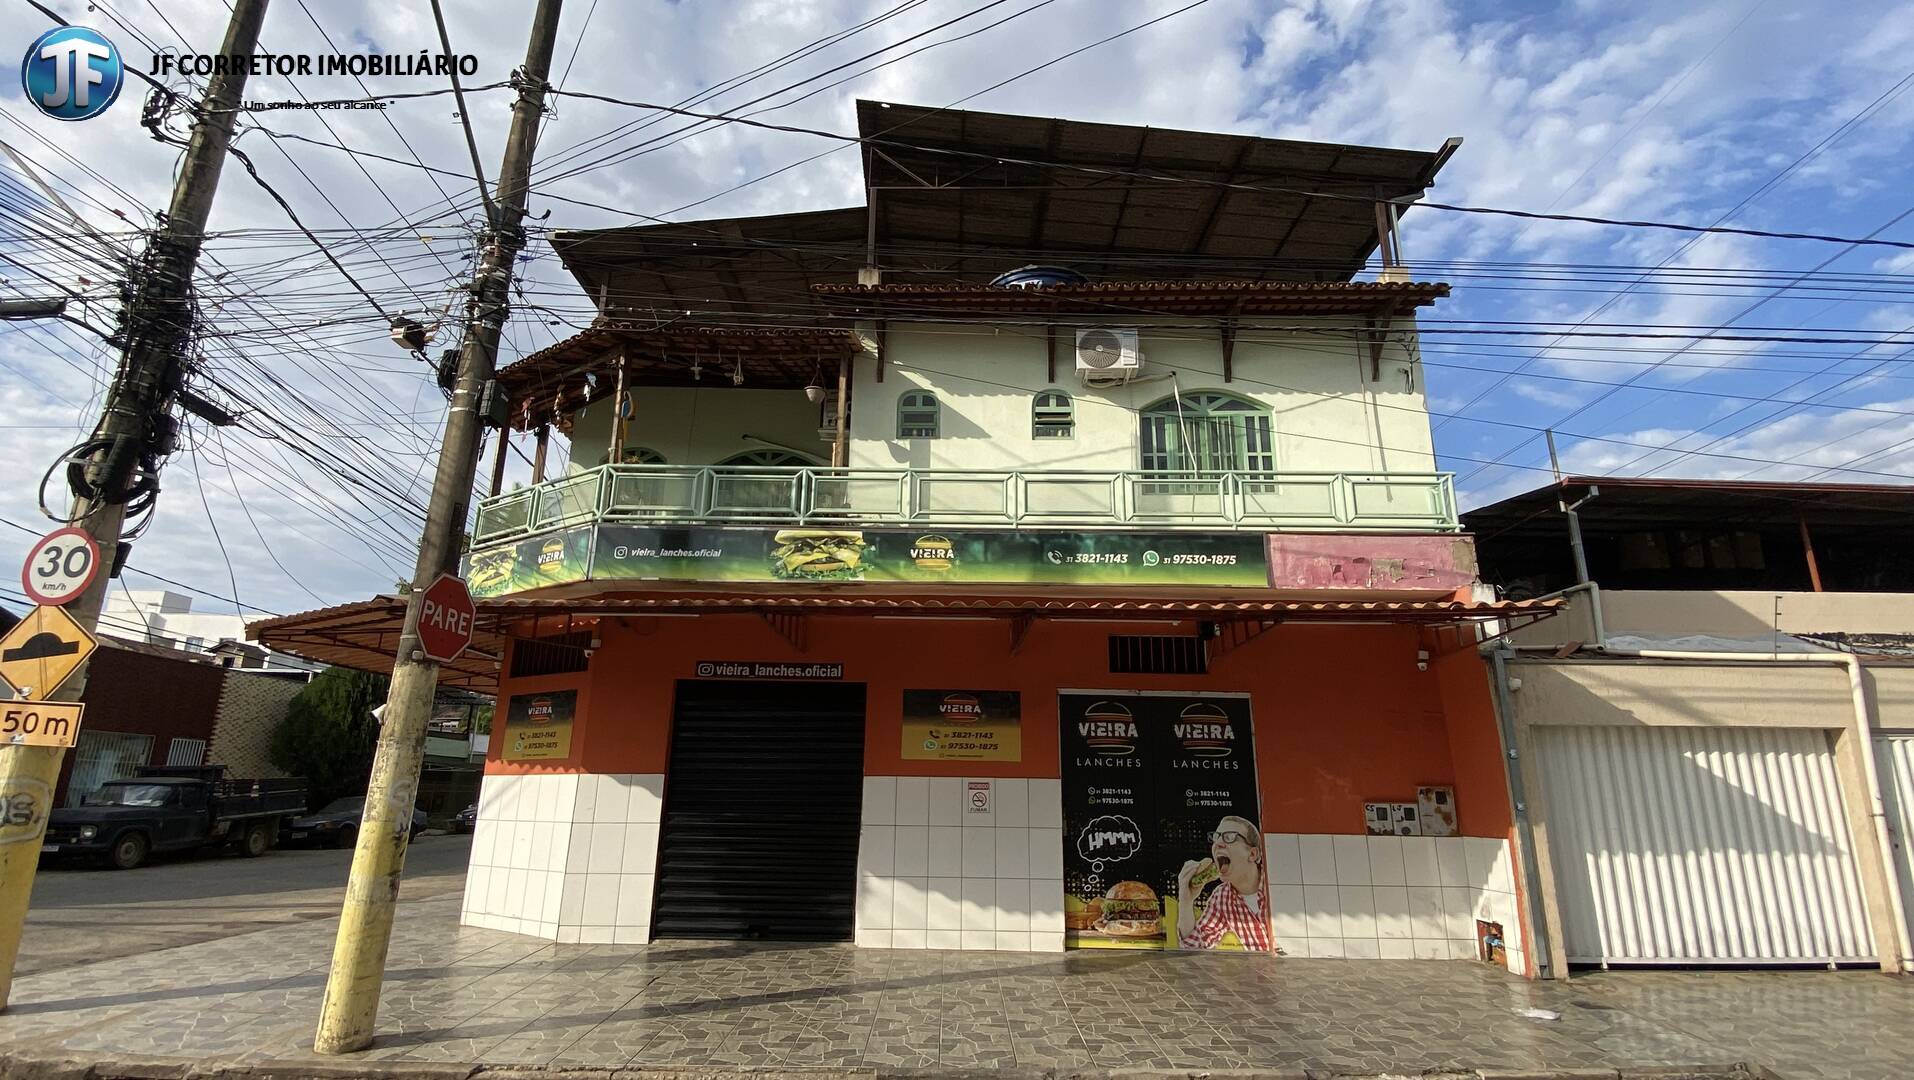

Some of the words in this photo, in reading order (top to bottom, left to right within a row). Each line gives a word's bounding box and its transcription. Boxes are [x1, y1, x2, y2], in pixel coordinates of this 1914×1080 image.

[537, 550, 565, 565] VIEIRA
[910, 548, 955, 559] VIEIRA
[1075, 553, 1128, 564] 3821-1143
[1172, 554, 1237, 565] 97530-1875
[37, 545, 92, 579] 30
[41, 581, 67, 591] km/h
[420, 600, 471, 636] PARE
[715, 663, 842, 678] vieira_lanches.oficial
[939, 704, 982, 713] VIEIRA
[2, 710, 39, 734] 50
[43, 717, 69, 736] m
[951, 731, 994, 740] 3821-1143
[1078, 722, 1139, 738] VIEIRA
[1173, 724, 1235, 740] VIEIRA
[1076, 757, 1142, 768] LANCHES
[1172, 759, 1239, 770] LANCHES
[1088, 831, 1136, 851] HMMM
